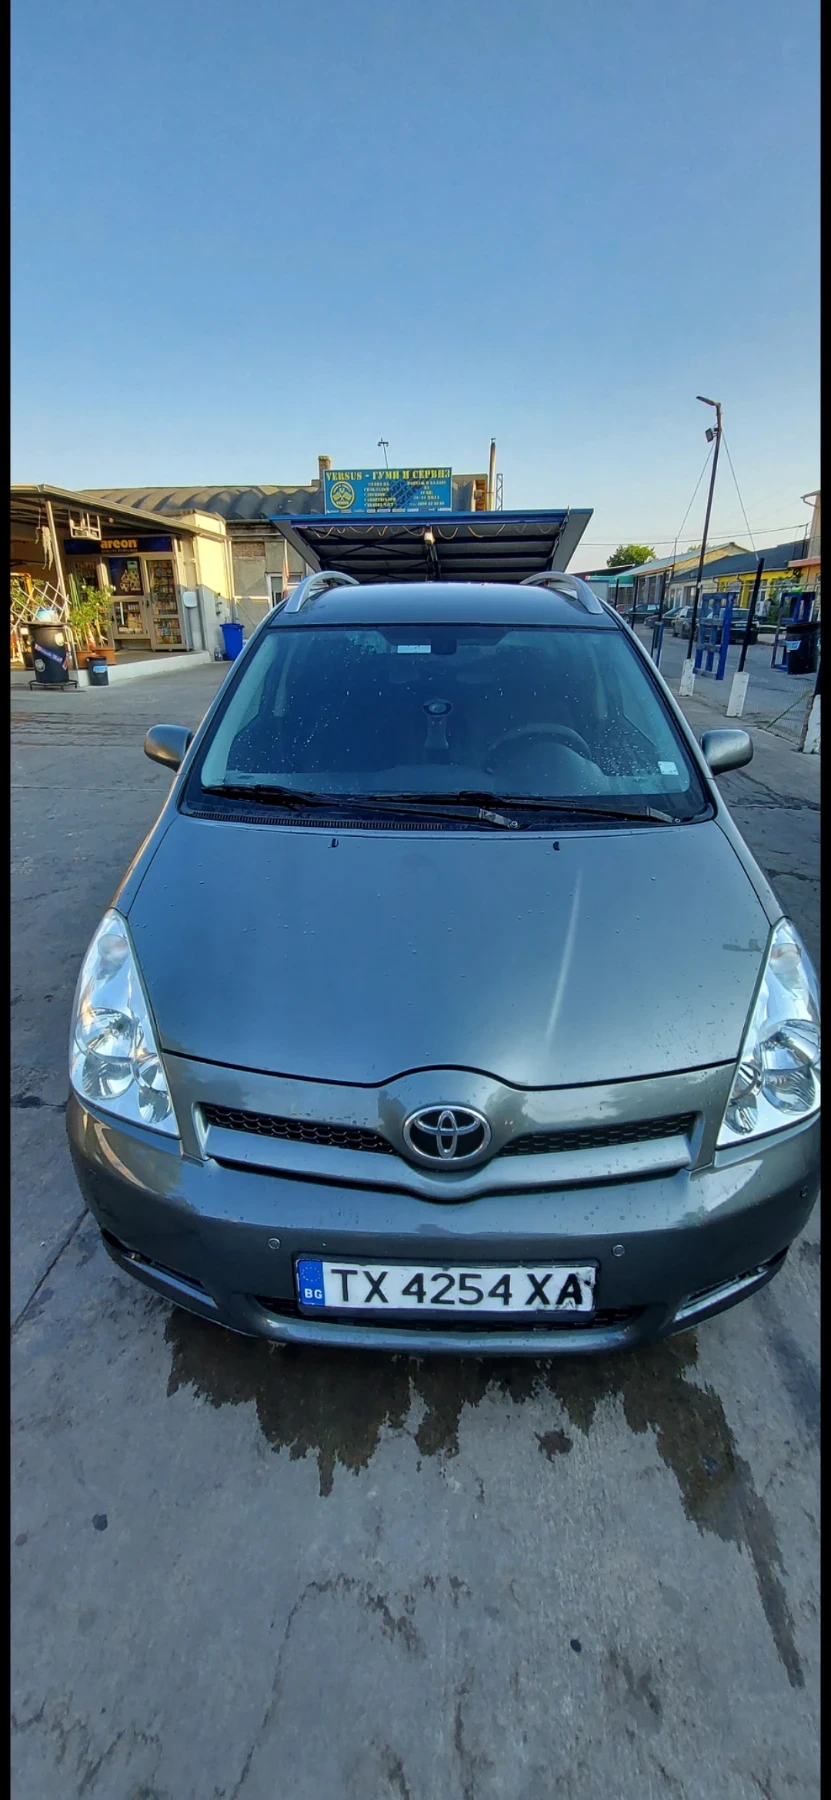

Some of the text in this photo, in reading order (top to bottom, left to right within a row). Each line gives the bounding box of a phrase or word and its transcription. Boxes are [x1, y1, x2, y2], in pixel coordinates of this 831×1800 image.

[326, 471, 362, 480] VERSUS
[372, 470, 400, 480] ГУМИ
[402, 470, 410, 479] И
[412, 469, 450, 479] СЕРВИЗ
[100, 540, 137, 549] areon
[331, 1269, 389, 1303] TX
[402, 1272, 512, 1305] 4254
[304, 1288, 323, 1300] BG
